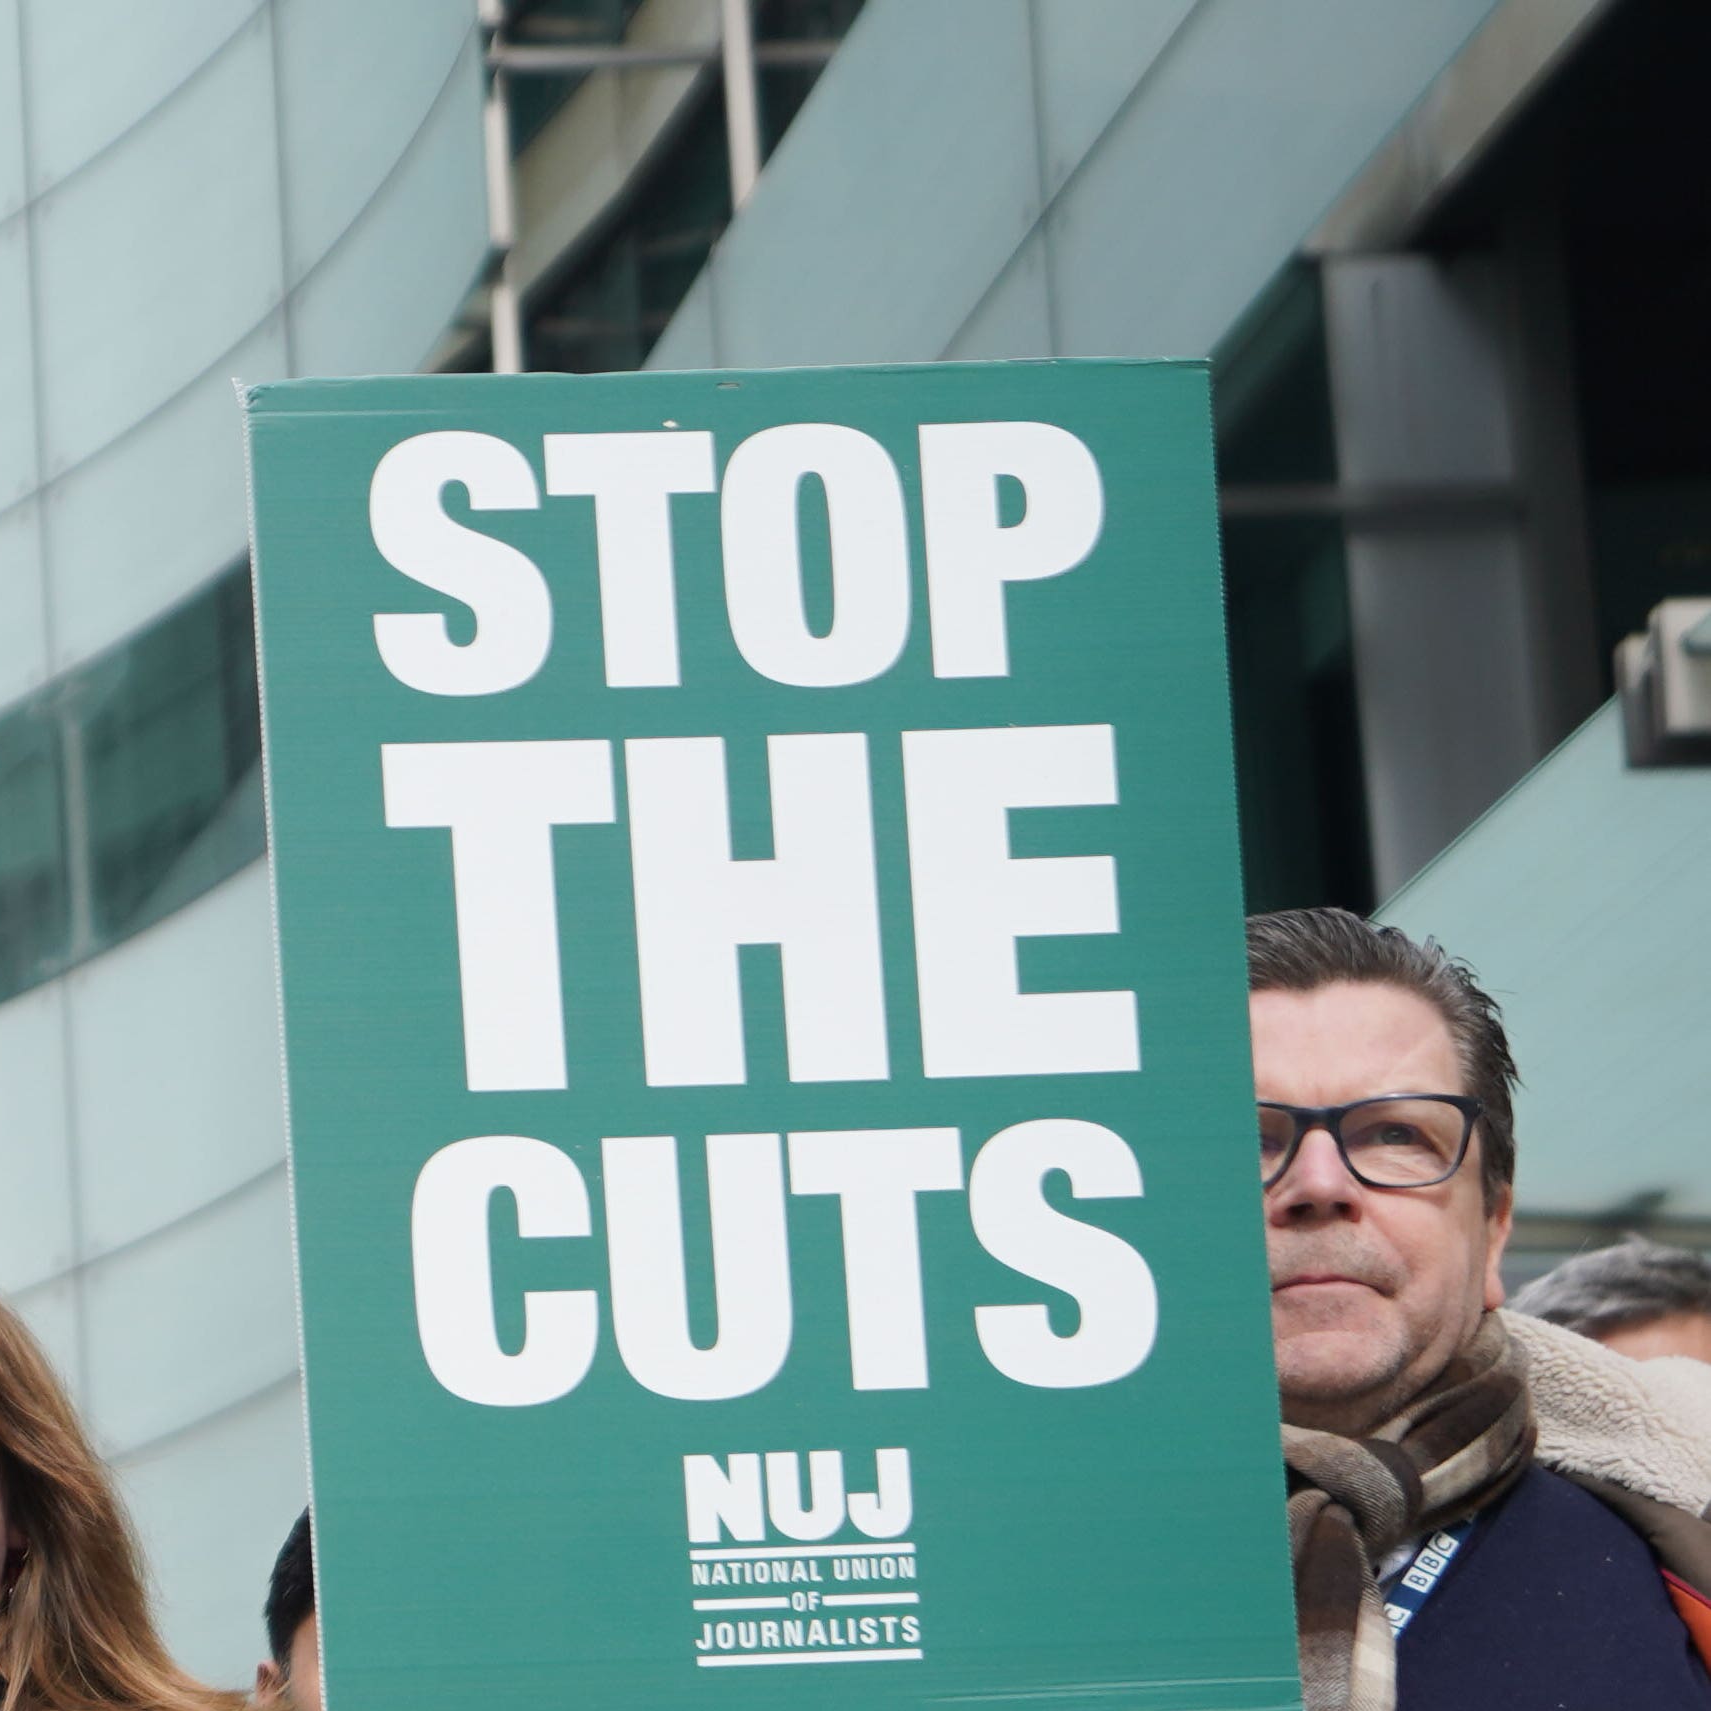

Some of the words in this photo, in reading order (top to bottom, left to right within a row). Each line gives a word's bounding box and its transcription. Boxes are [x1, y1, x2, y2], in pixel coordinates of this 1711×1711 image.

[370, 422, 1104, 697] STOP
[380, 723, 1141, 1092] THE
[411, 1118, 1158, 1407] CUTS
[683, 1448, 913, 1543] NUJ
[691, 1560, 823, 1585] NATIONAL
[833, 1557, 916, 1581] UNION
[1408, 1532, 1454, 1587] BBC
[695, 1616, 921, 1650] JOURNALISTS
[791, 1592, 821, 1612] OF
